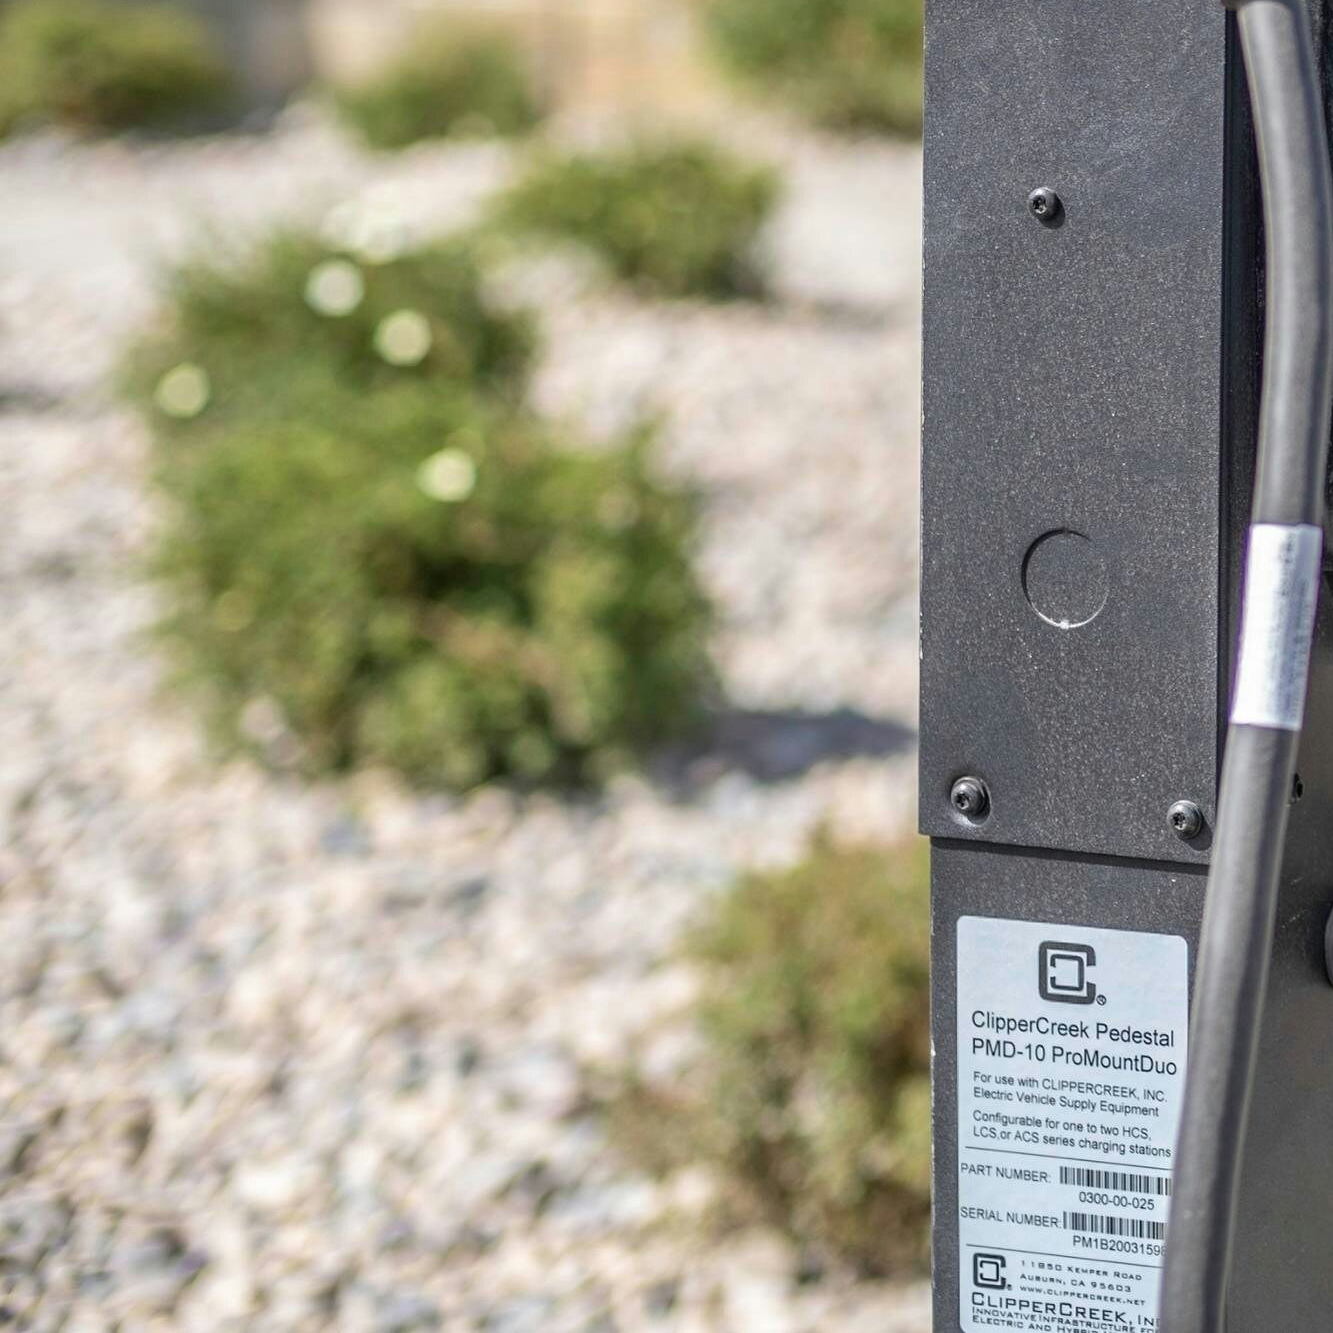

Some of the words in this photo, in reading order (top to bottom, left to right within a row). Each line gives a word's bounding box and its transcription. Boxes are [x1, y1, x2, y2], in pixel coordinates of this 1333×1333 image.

[972, 1010, 1090, 1039] ClipperCreek
[1096, 1022, 1175, 1047] Pedestal
[972, 1037, 1046, 1062] PMD-10
[1052, 1045, 1177, 1075] ProMountDuo
[973, 1071, 991, 1083] For
[995, 1075, 1014, 1086] use
[1017, 1076, 1039, 1088] with
[1042, 1078, 1140, 1101] CLIPPERCREEK,
[1143, 1089, 1167, 1103] INC.
[973, 1086, 1013, 1101] Electric
[1016, 1091, 1056, 1106] Vehicle
[1059, 1096, 1096, 1113] Supply
[1100, 1100, 1159, 1117] Equipment
[973, 1109, 1042, 1128] Configurable
[1045, 1117, 1060, 1129] for
[1063, 1120, 1083, 1132] one
[1087, 1122, 1097, 1134] to
[1100, 1124, 1119, 1136] two
[1123, 1126, 1151, 1141] HCS,
[1014, 1130, 1039, 1143] ACS
[1042, 1134, 1075, 1147] series
[1078, 1138, 1125, 1155] charging
[1129, 1143, 1172, 1158] stations
[960, 1162, 993, 1176] PART
[996, 1166, 1052, 1184] NUMBER:
[1079, 1191, 1155, 1210] 0300-00-025
[960, 1206, 1003, 1222] SERIAL
[1006, 1211, 1062, 1229] NUMBER:
[1071, 1279, 1085, 1287] CA
[1091, 1281, 1131, 1293] 95603
[1028, 1323, 1052, 1332] AND
